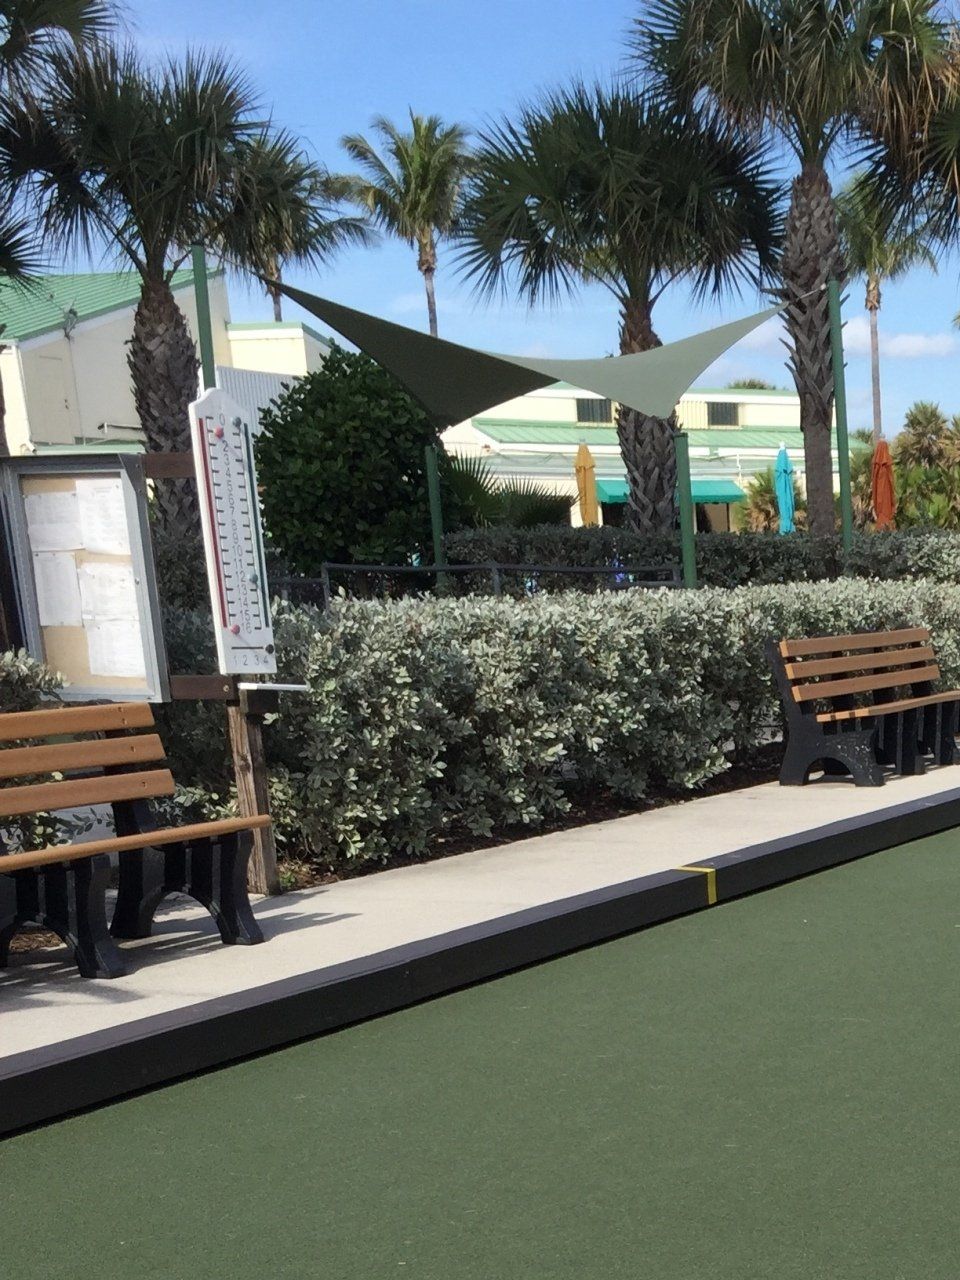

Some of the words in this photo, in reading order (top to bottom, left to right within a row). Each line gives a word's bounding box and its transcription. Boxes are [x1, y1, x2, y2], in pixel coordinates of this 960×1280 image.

[222, 440, 229, 452] 2
[229, 506, 235, 516] 7
[232, 544, 243, 557] 10
[235, 570, 246, 583] 12
[243, 654, 249, 666] 2
[254, 654, 260, 666] 3
